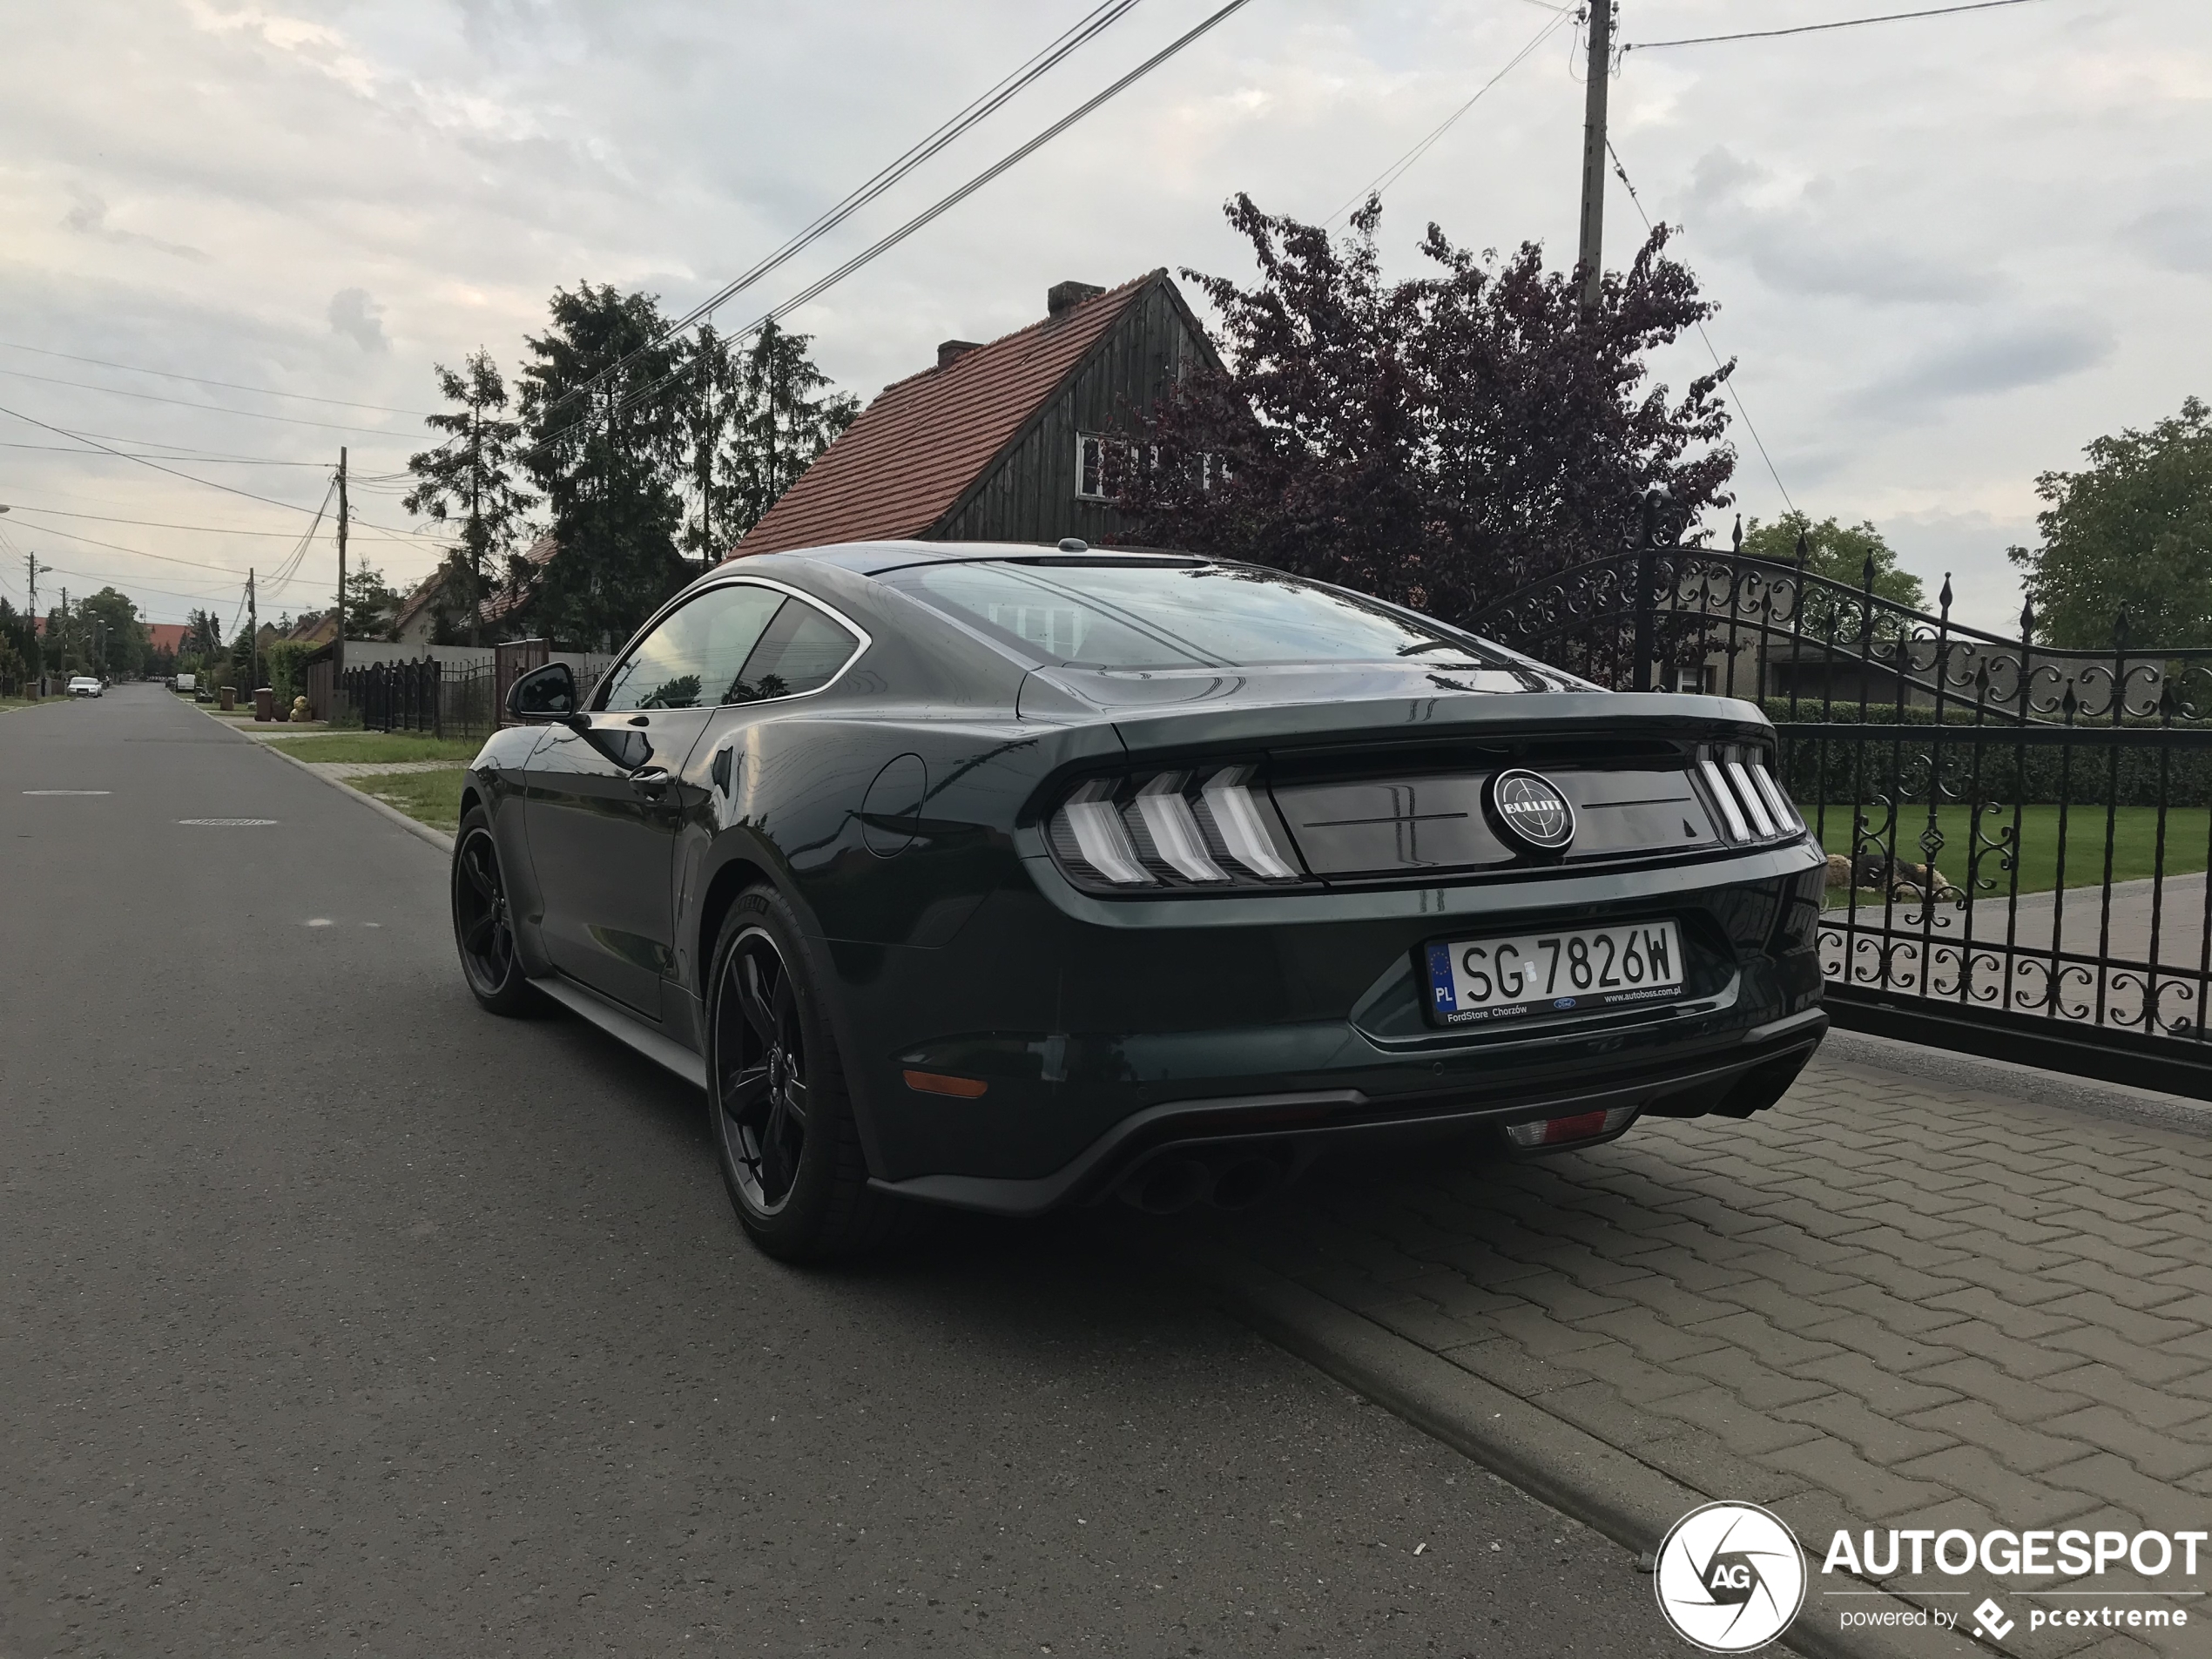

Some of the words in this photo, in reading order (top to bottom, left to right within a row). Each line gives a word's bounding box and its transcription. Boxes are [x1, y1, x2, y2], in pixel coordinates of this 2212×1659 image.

[1503, 800, 1560, 814] BULLITT
[729, 896, 766, 914] CHELIN
[1462, 944, 1524, 1001] SG
[1538, 928, 1670, 994] 7826W
[1435, 987, 1453, 1002] PL
[1604, 986, 1682, 1002] www.autoboss.com.pl
[1447, 1009, 1488, 1022] FordStore
[1492, 1005, 1527, 1017] Chorzów
